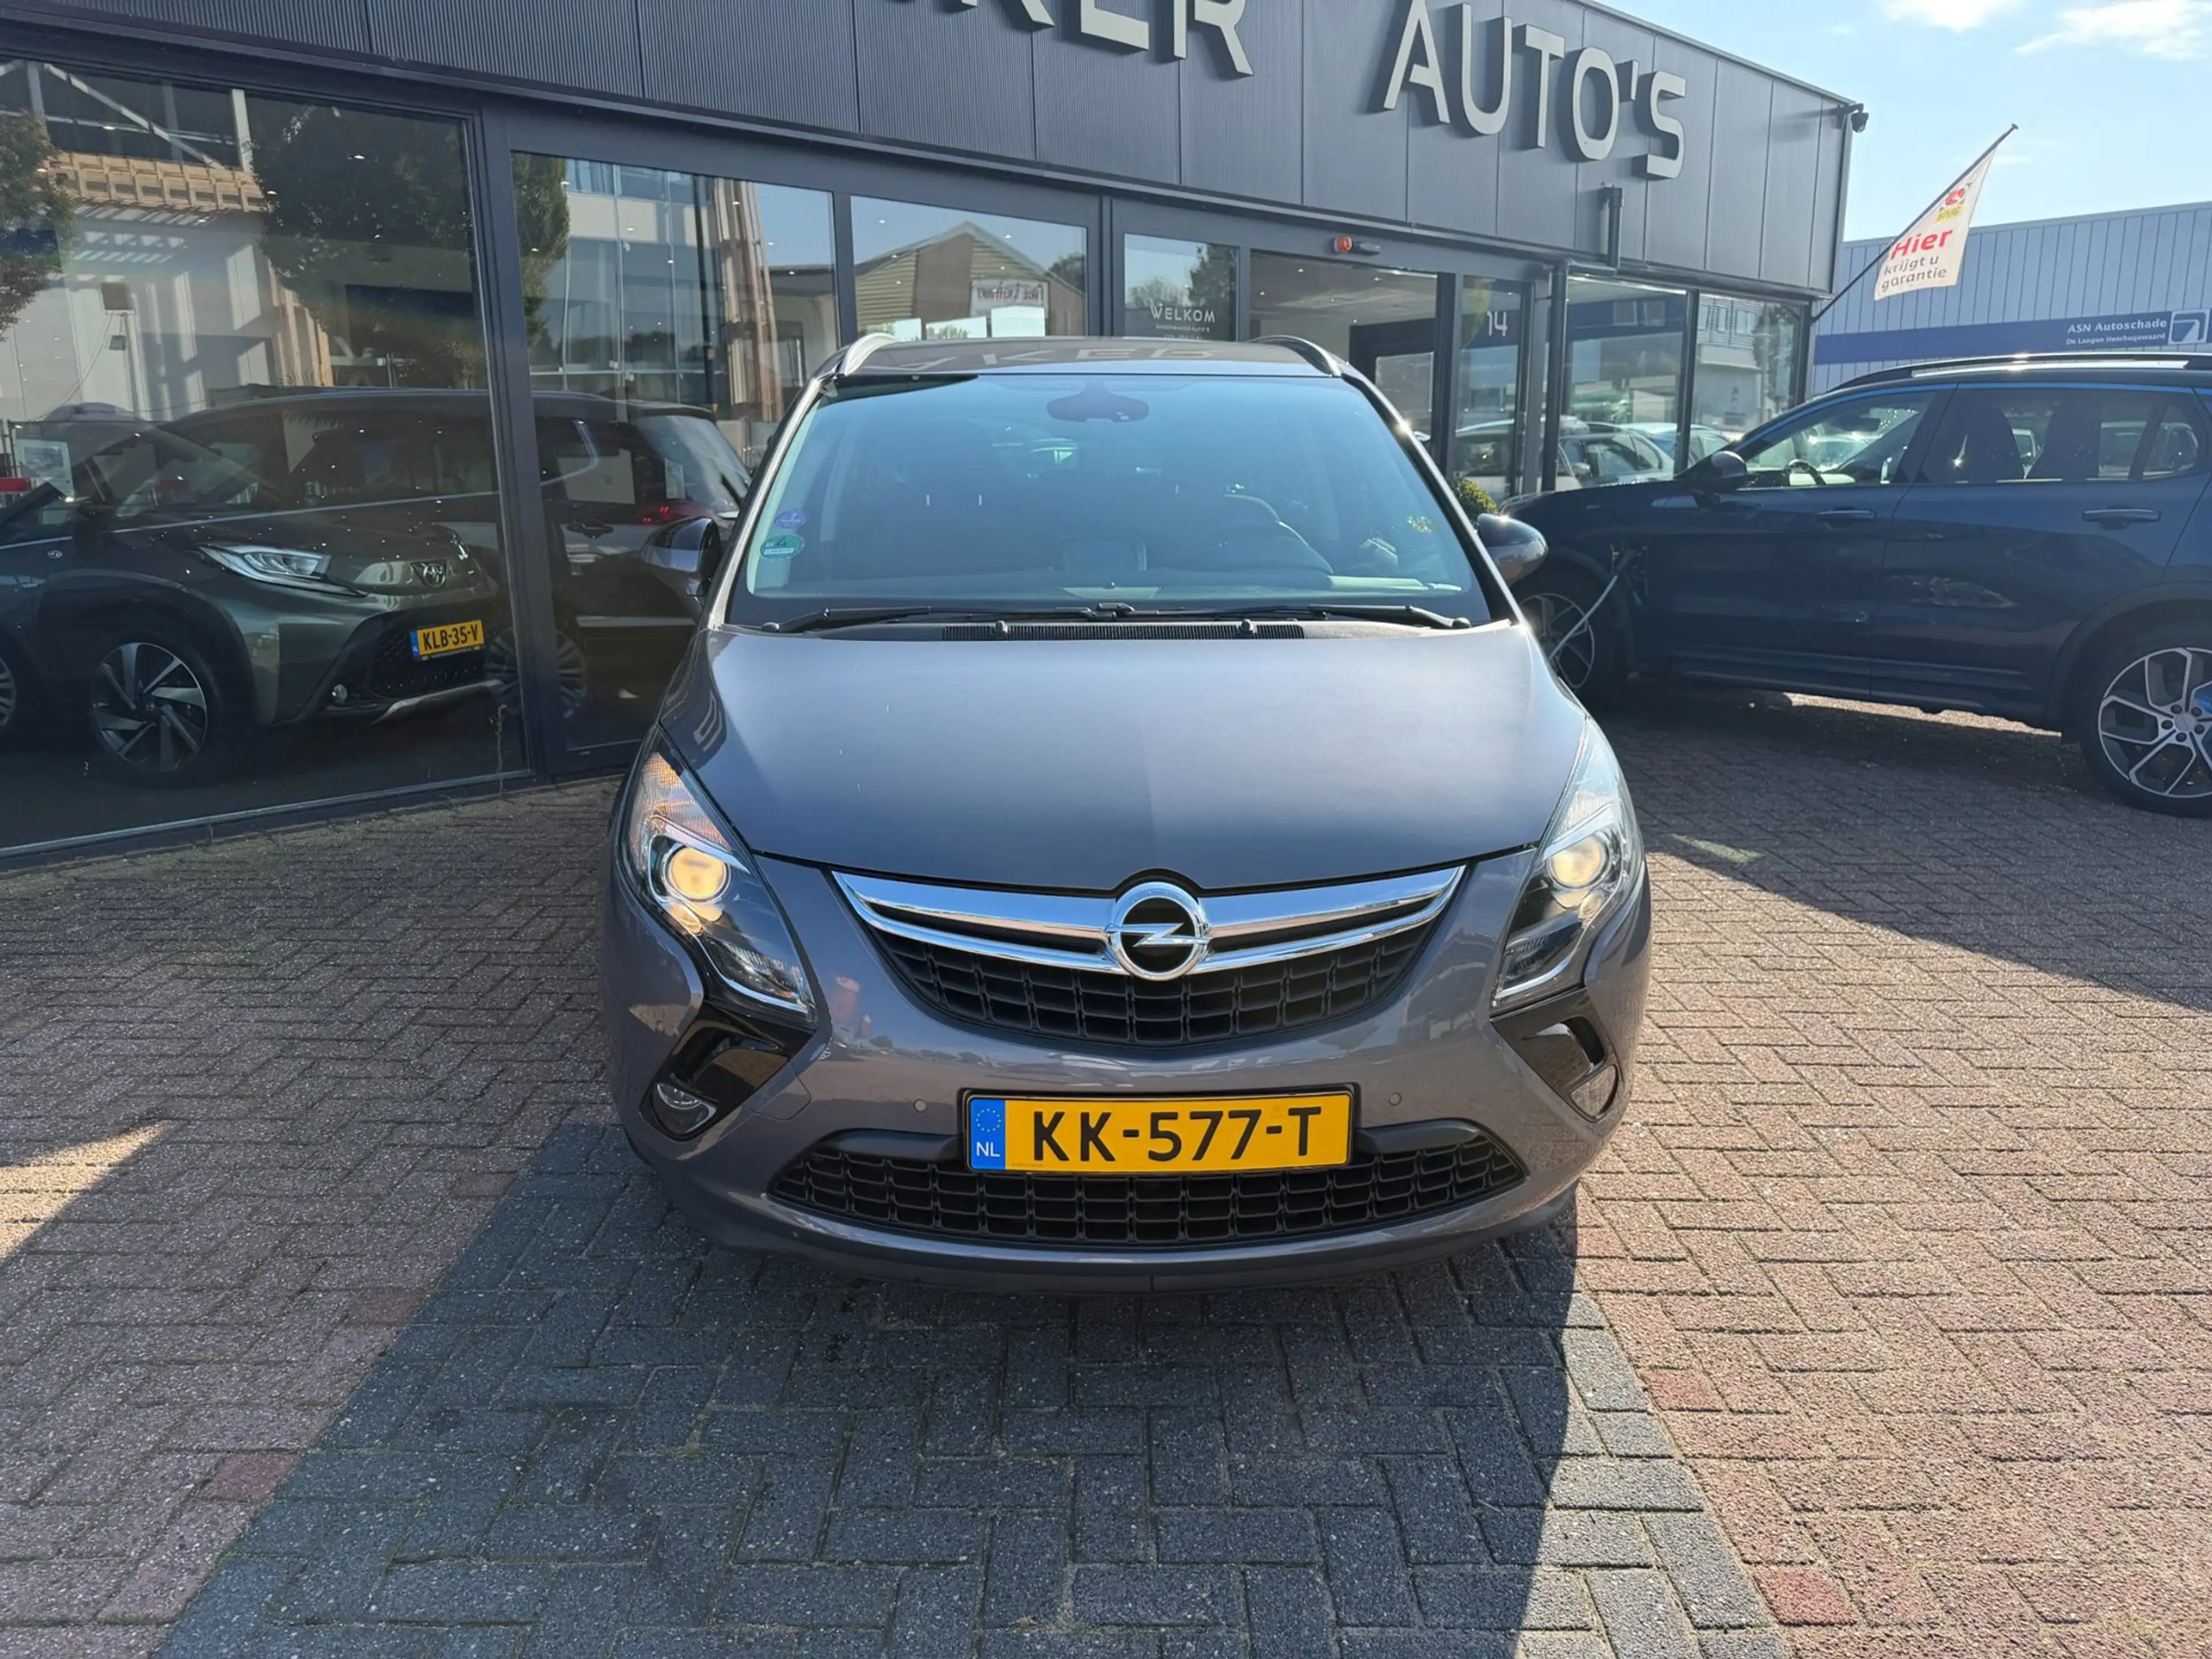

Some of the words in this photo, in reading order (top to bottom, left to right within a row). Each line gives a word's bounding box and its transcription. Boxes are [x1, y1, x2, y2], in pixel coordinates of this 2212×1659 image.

[1384, 0, 1685, 179] AUTO'S
[1890, 229, 1953, 260] Hier
[1884, 256, 1925, 276] krijgt
[1931, 256, 1939, 265] u
[1881, 267, 1946, 292] garantie
[1150, 306, 1215, 323] WELKOM
[1487, 311, 1508, 337] 14
[2067, 323, 2091, 333] ASN
[2095, 319, 2167, 332] Autoschade
[423, 624, 478, 650] KLB-35-V
[976, 1141, 1001, 1157] NL
[1033, 1106, 1321, 1162] KK-577-T
